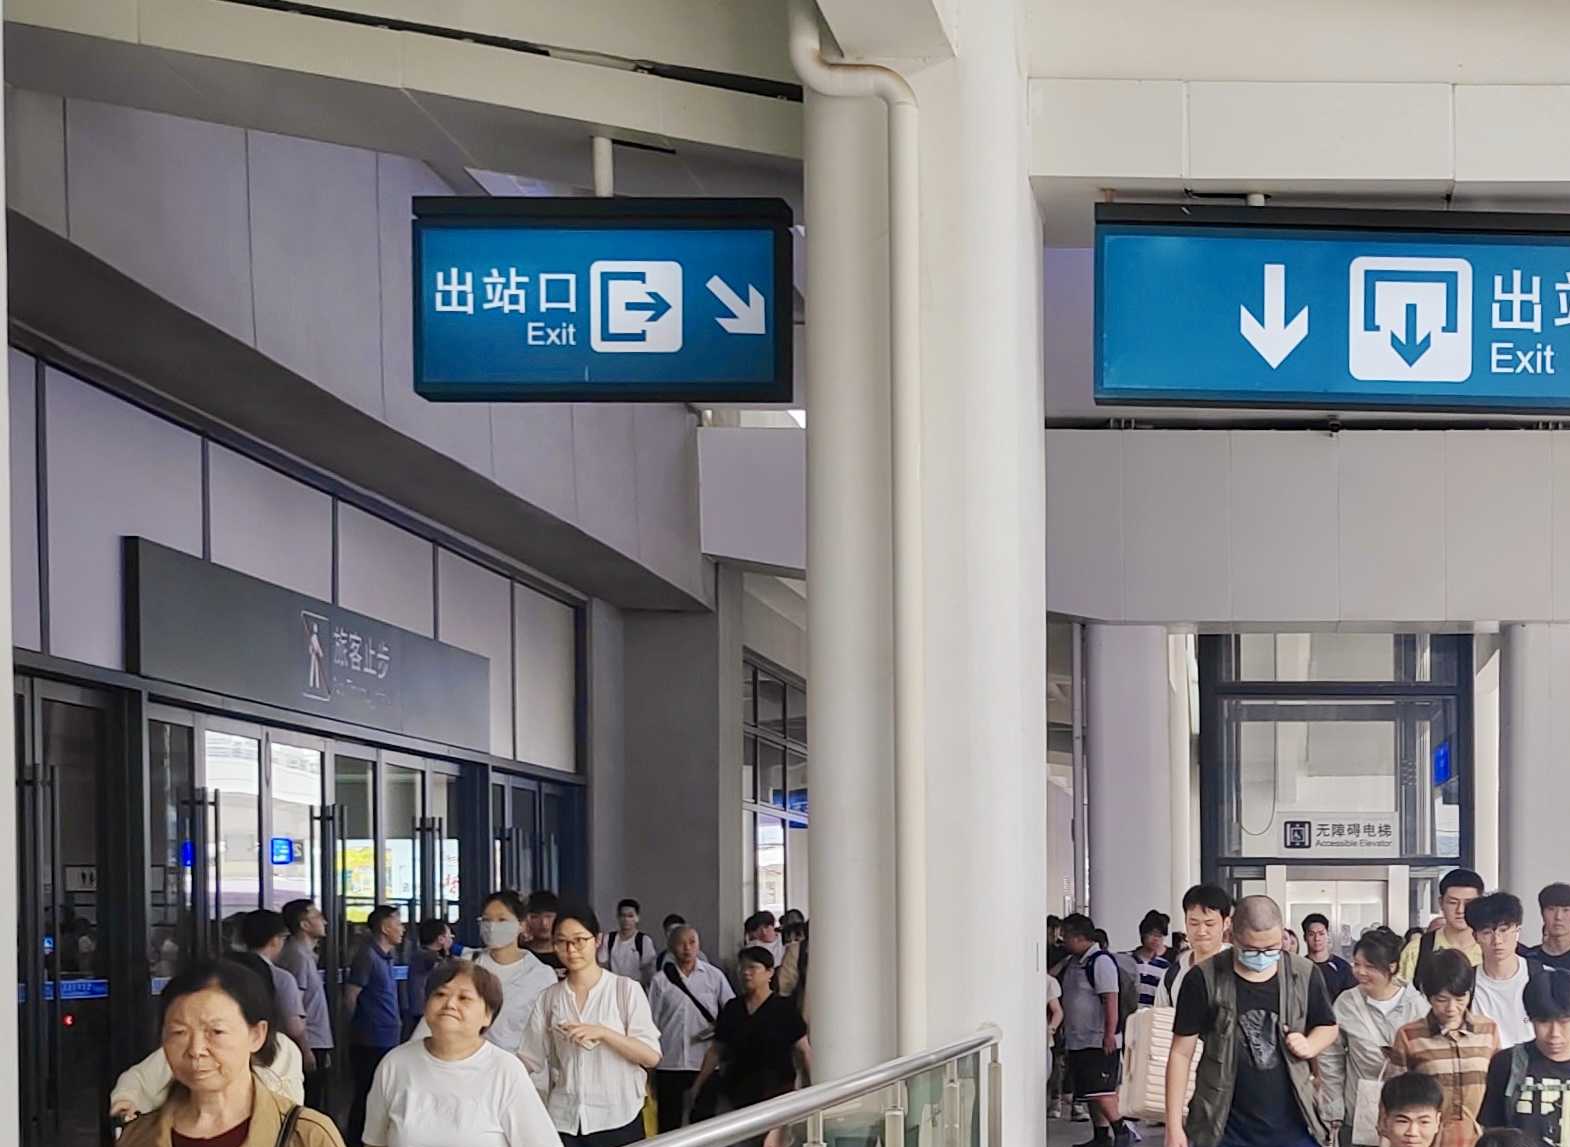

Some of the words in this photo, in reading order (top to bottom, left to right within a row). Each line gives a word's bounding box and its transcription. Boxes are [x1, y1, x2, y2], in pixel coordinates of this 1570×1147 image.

[435, 267, 577, 315] 出站口
[527, 322, 577, 346] Exit
[1491, 342, 1555, 374] Exit
[333, 625, 391, 679] 旅客止步
[1316, 823, 1393, 838] 无障碍电梯
